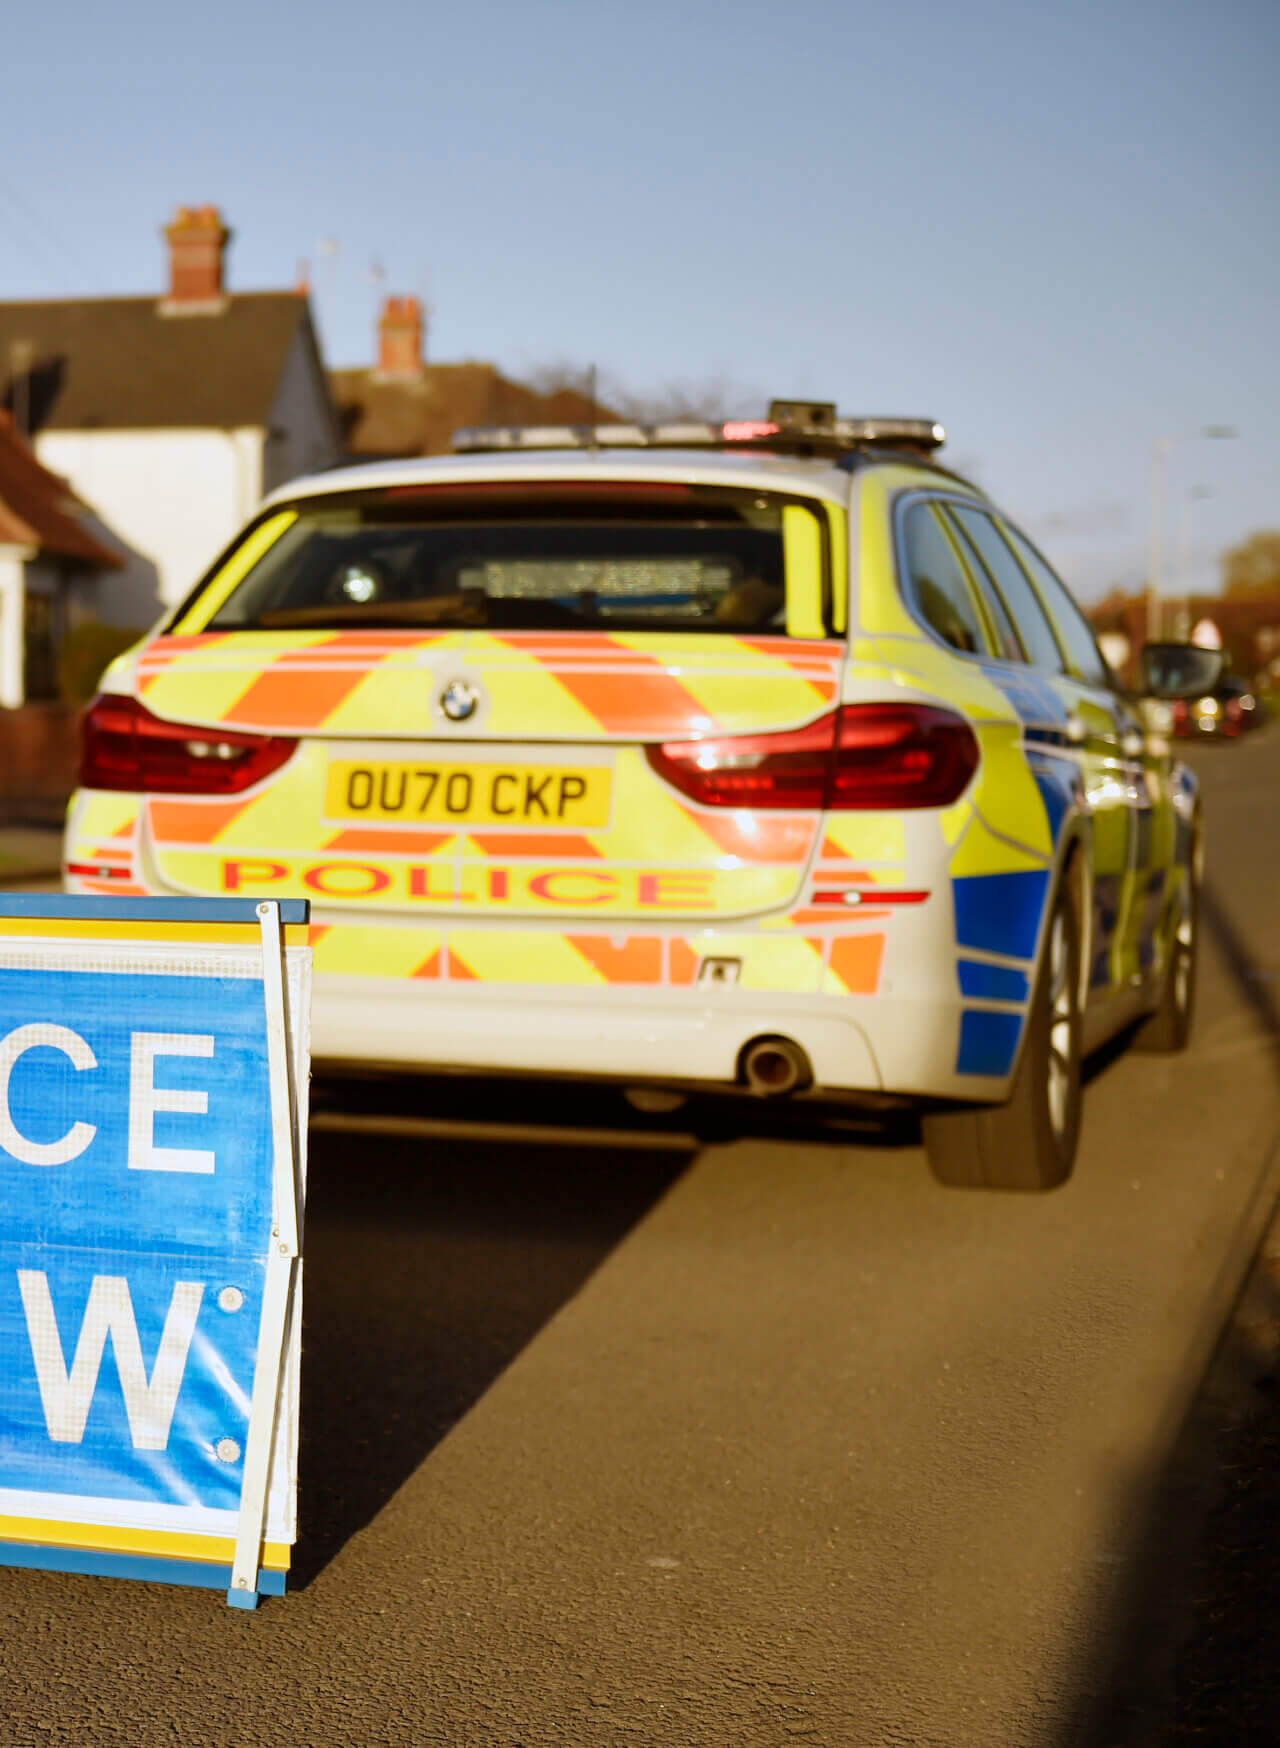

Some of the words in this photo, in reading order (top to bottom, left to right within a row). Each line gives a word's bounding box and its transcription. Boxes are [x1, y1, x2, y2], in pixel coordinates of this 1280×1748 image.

[346, 769, 474, 815] OU70
[489, 773, 588, 818] CKP
[222, 860, 717, 908] POLICE
